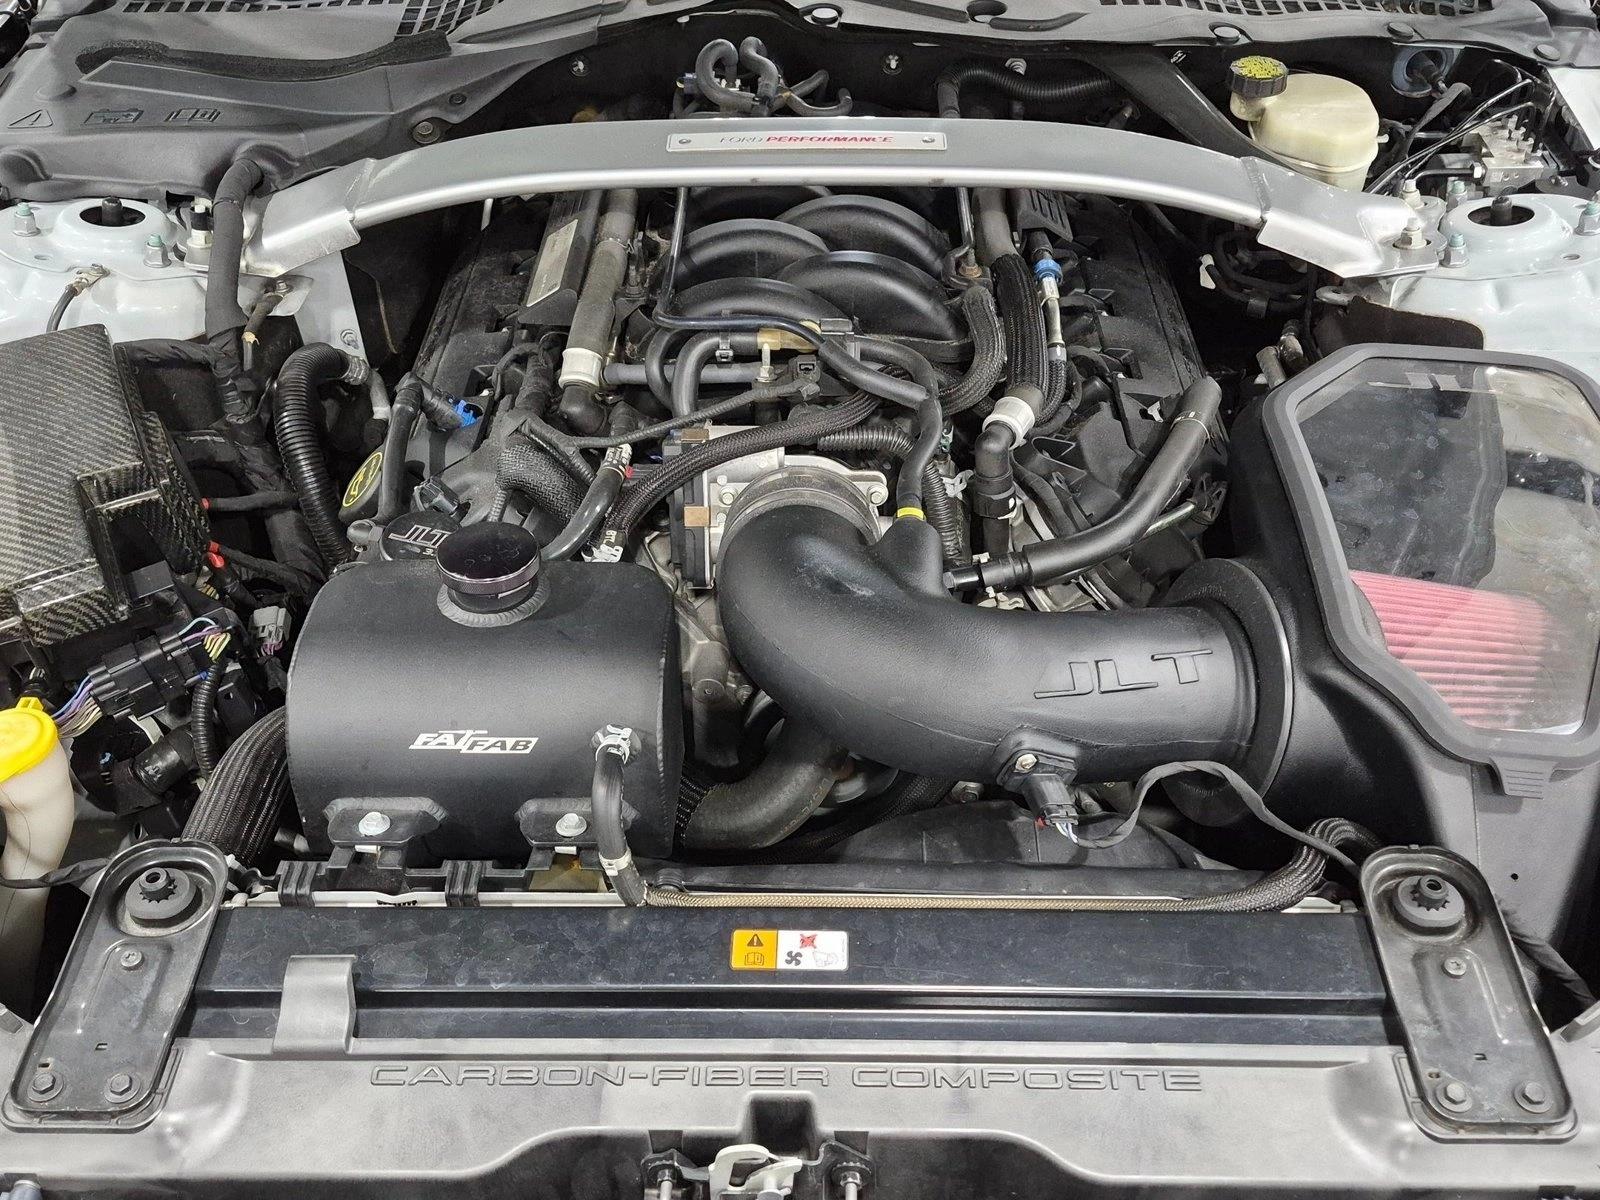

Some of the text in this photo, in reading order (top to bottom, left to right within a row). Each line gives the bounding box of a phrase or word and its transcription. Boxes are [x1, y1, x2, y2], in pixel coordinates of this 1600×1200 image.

[766, 135, 894, 143] PERFORMANCE
[388, 524, 452, 549] JLT
[1033, 649, 1214, 700] JLT
[369, 1065, 1203, 1092] CARBON-FIBER COMPOSITE
